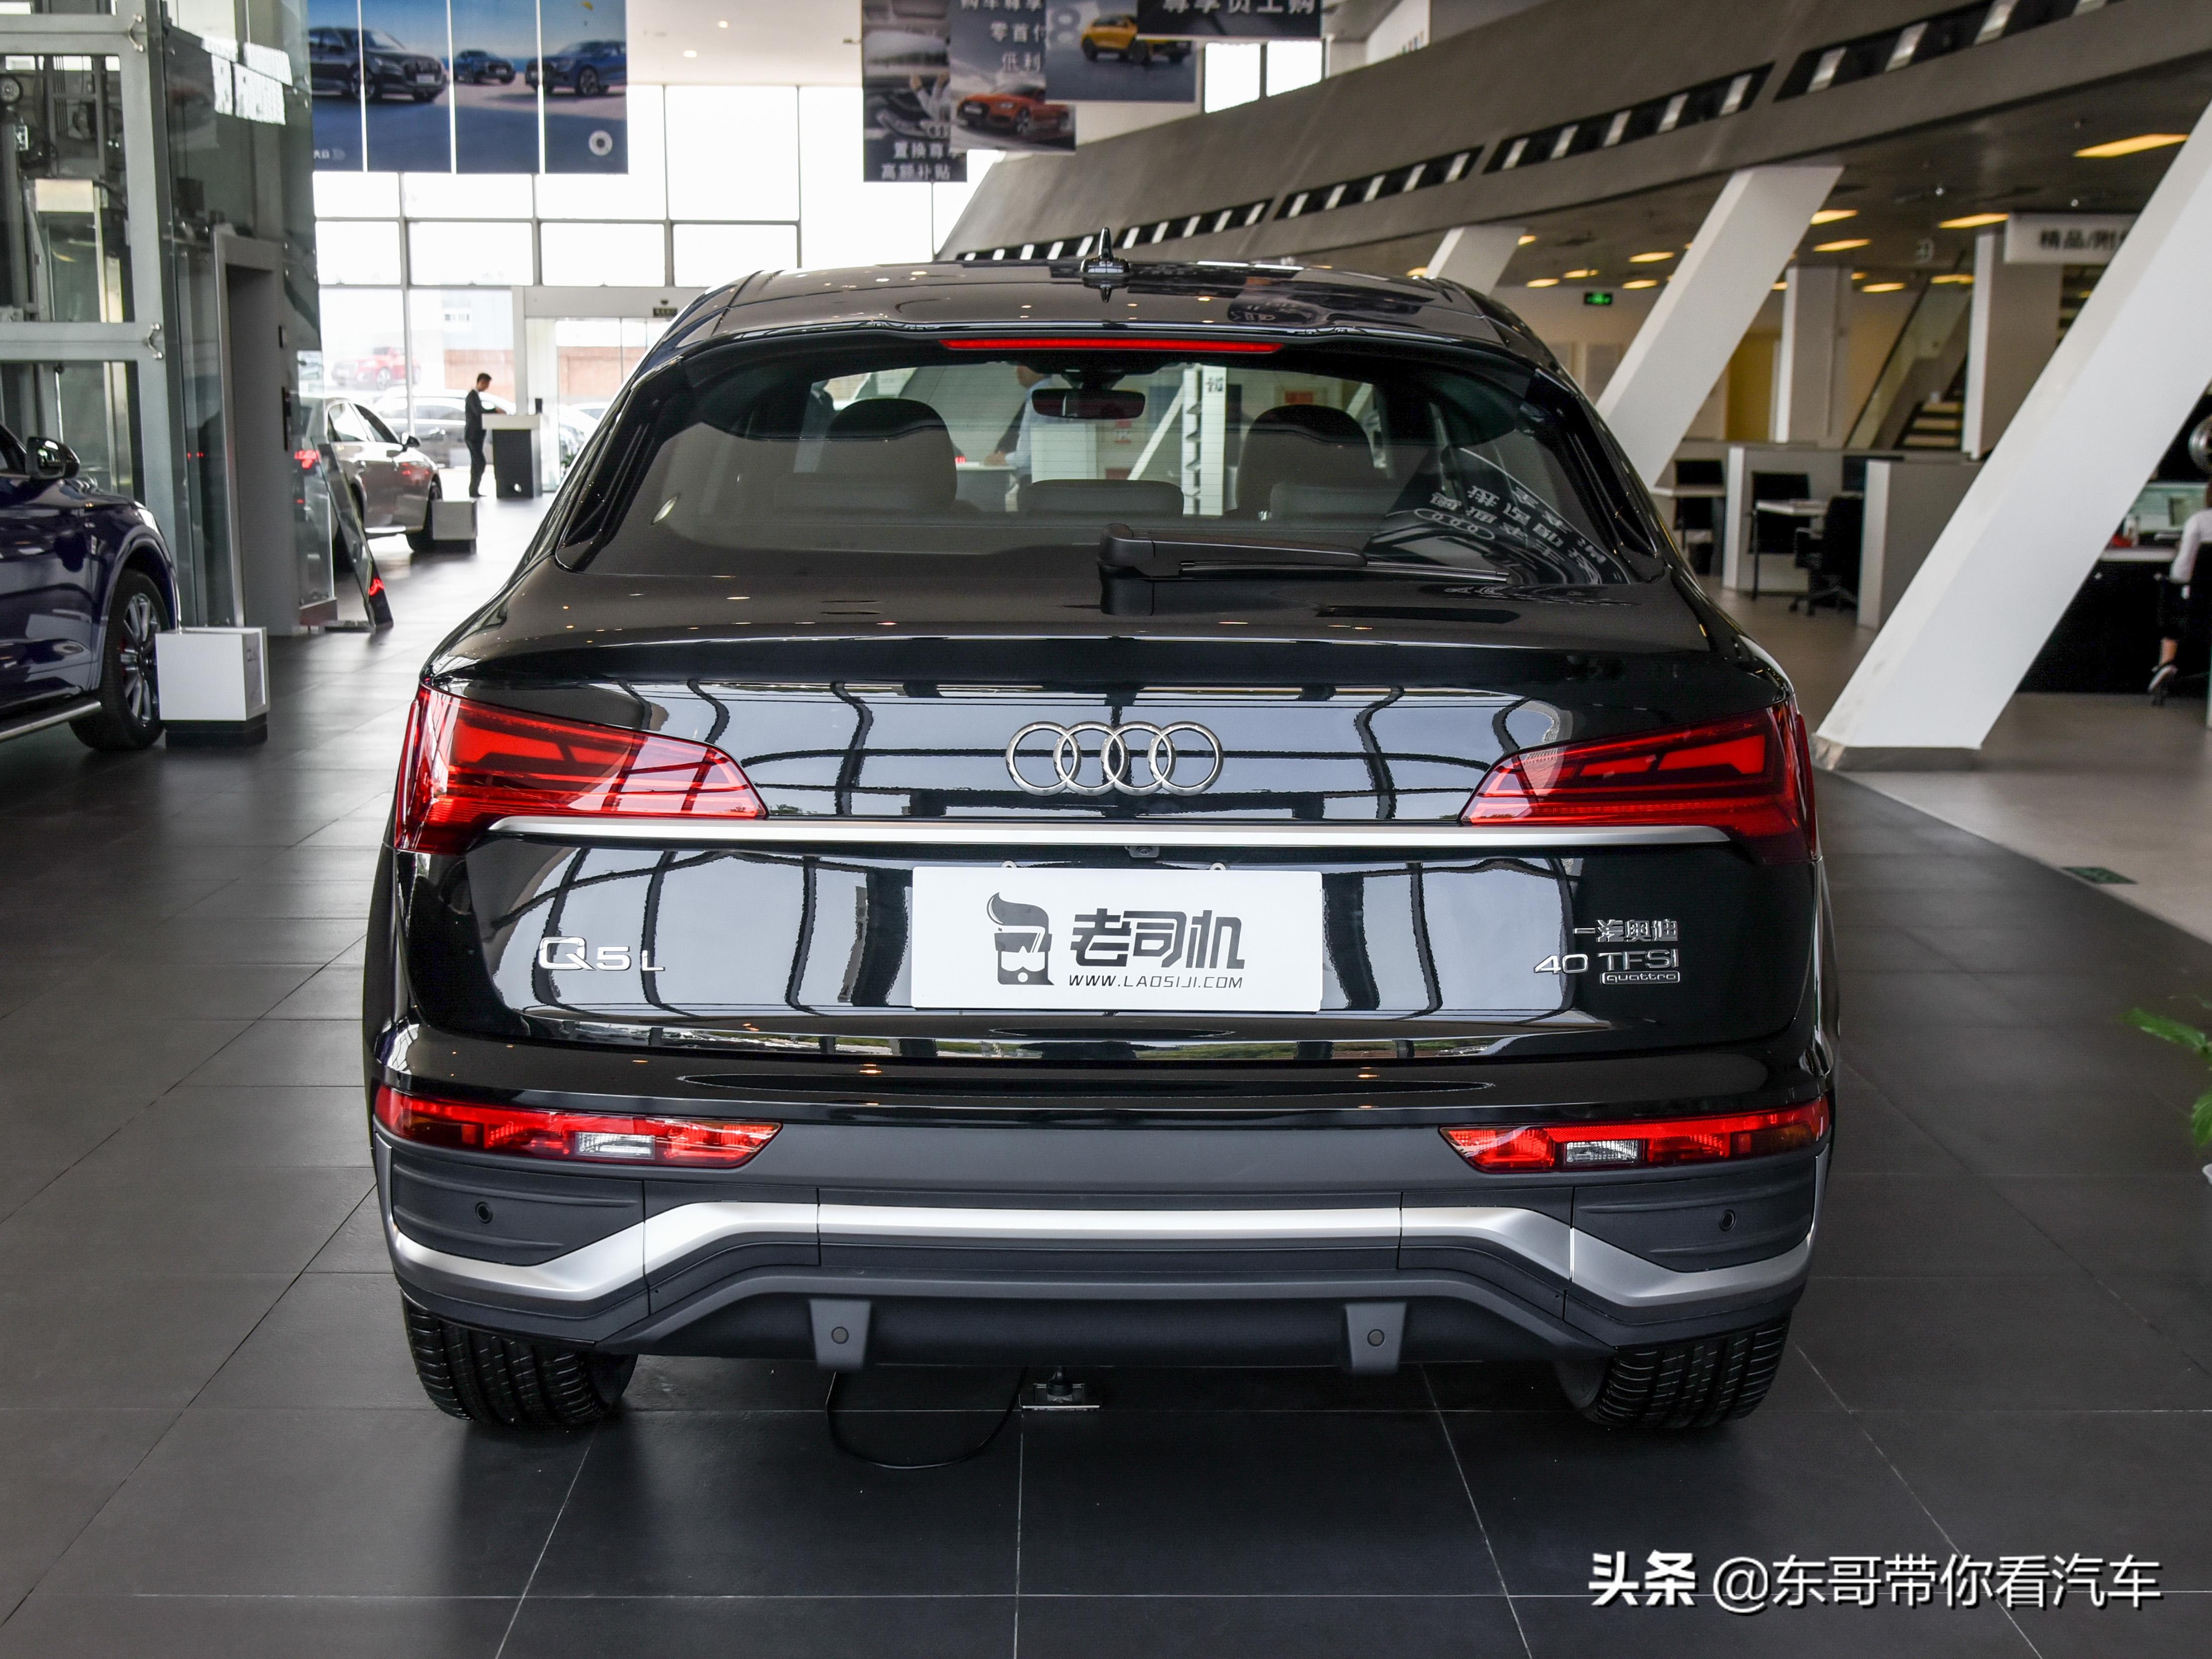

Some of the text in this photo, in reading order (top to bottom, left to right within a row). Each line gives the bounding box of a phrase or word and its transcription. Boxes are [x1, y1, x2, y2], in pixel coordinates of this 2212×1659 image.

[1070, 908, 1245, 969] 老司机
[1573, 919, 1678, 943] 一汽奥迪
[1534, 948, 1679, 974] 40 TFSI
[1069, 974, 1243, 989] WWW.LAOSIJI.COM
[1606, 972, 1677, 983] quattro
